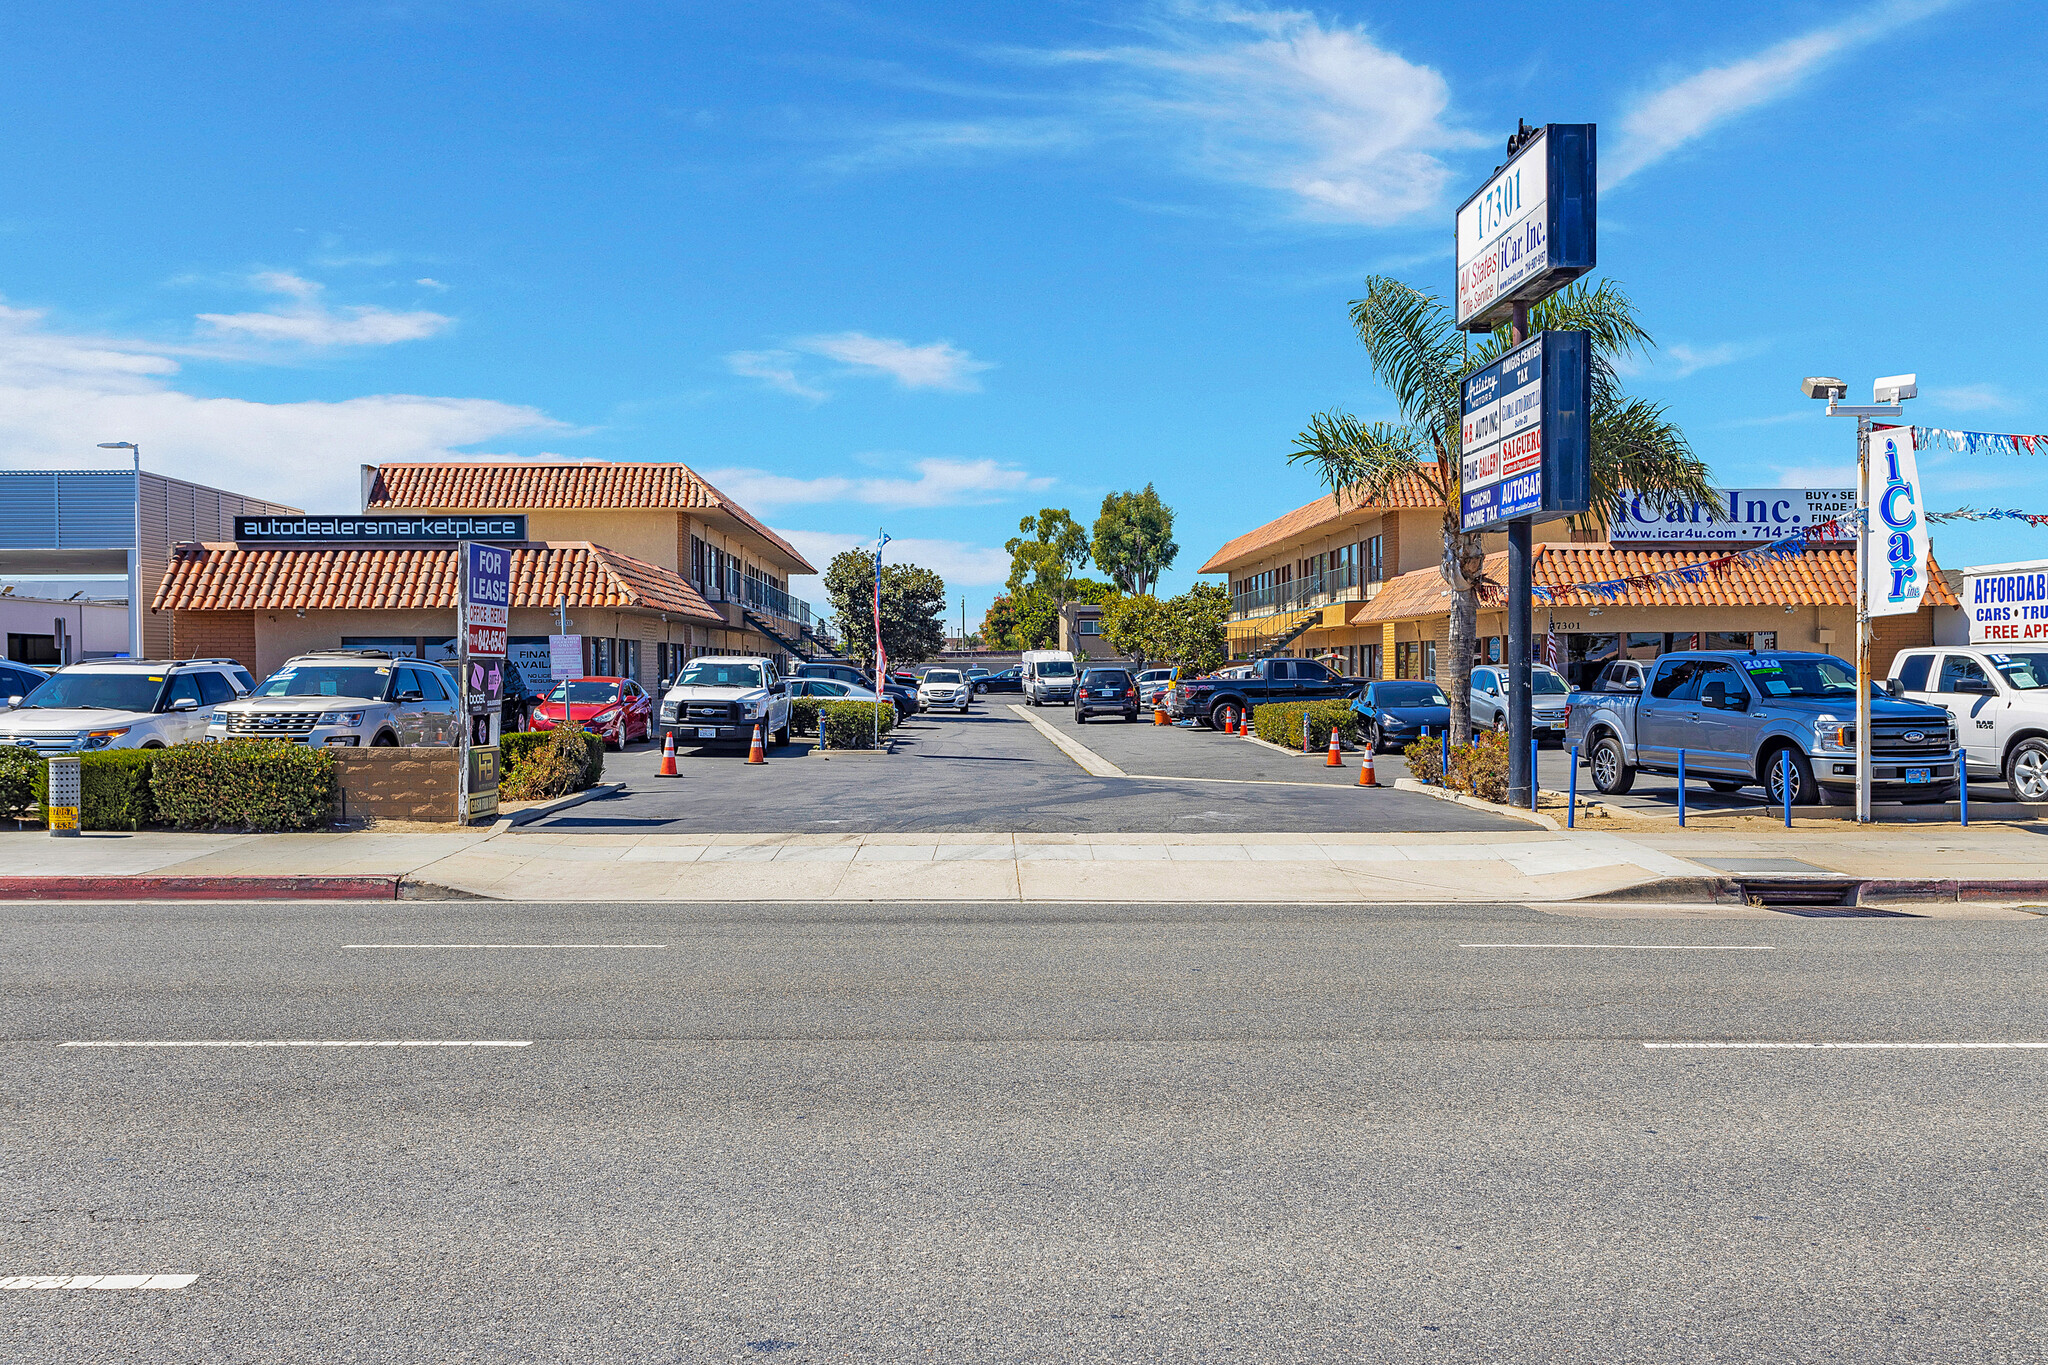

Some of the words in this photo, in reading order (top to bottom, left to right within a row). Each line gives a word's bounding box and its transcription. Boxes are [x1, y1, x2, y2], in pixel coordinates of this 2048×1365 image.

[1478, 167, 1522, 241] 17301
[1500, 236, 1524, 272] iCar,
[1525, 219, 1546, 255] Inc.
[1459, 263, 1470, 299] All
[1471, 251, 1498, 289] States
[1474, 283, 1494, 312] Service
[1517, 366, 1529, 385] TAX
[1471, 391, 1493, 409] MOTORS
[1475, 415, 1488, 440] AUTO
[1464, 460, 1478, 485] FRAME
[1478, 452, 1499, 479] GALLERY
[1470, 489, 1491, 510] CHICHO
[1805, 491, 1829, 500] BUY
[1464, 507, 1485, 529] INCOME
[1486, 504, 1498, 523] TAX
[1727, 490, 1801, 525] Inc.
[243, 518, 516, 538] autodealersmarketplace
[1614, 527, 1737, 540] www.icar4u.com
[479, 550, 502, 575] FOR
[473, 576, 506, 603] LEASE
[1974, 573, 2048, 604] AFFORDAB
[469, 604, 487, 622] OFFICE
[490, 606, 507, 624] RETAIL
[1976, 606, 2011, 622] CARS
[478, 628, 506, 653] 842-6543
[1984, 624, 2019, 639] FREE
[1742, 659, 1781, 670] 2020
[1990, 654, 2012, 664] 15
[469, 691, 486, 705] boost
